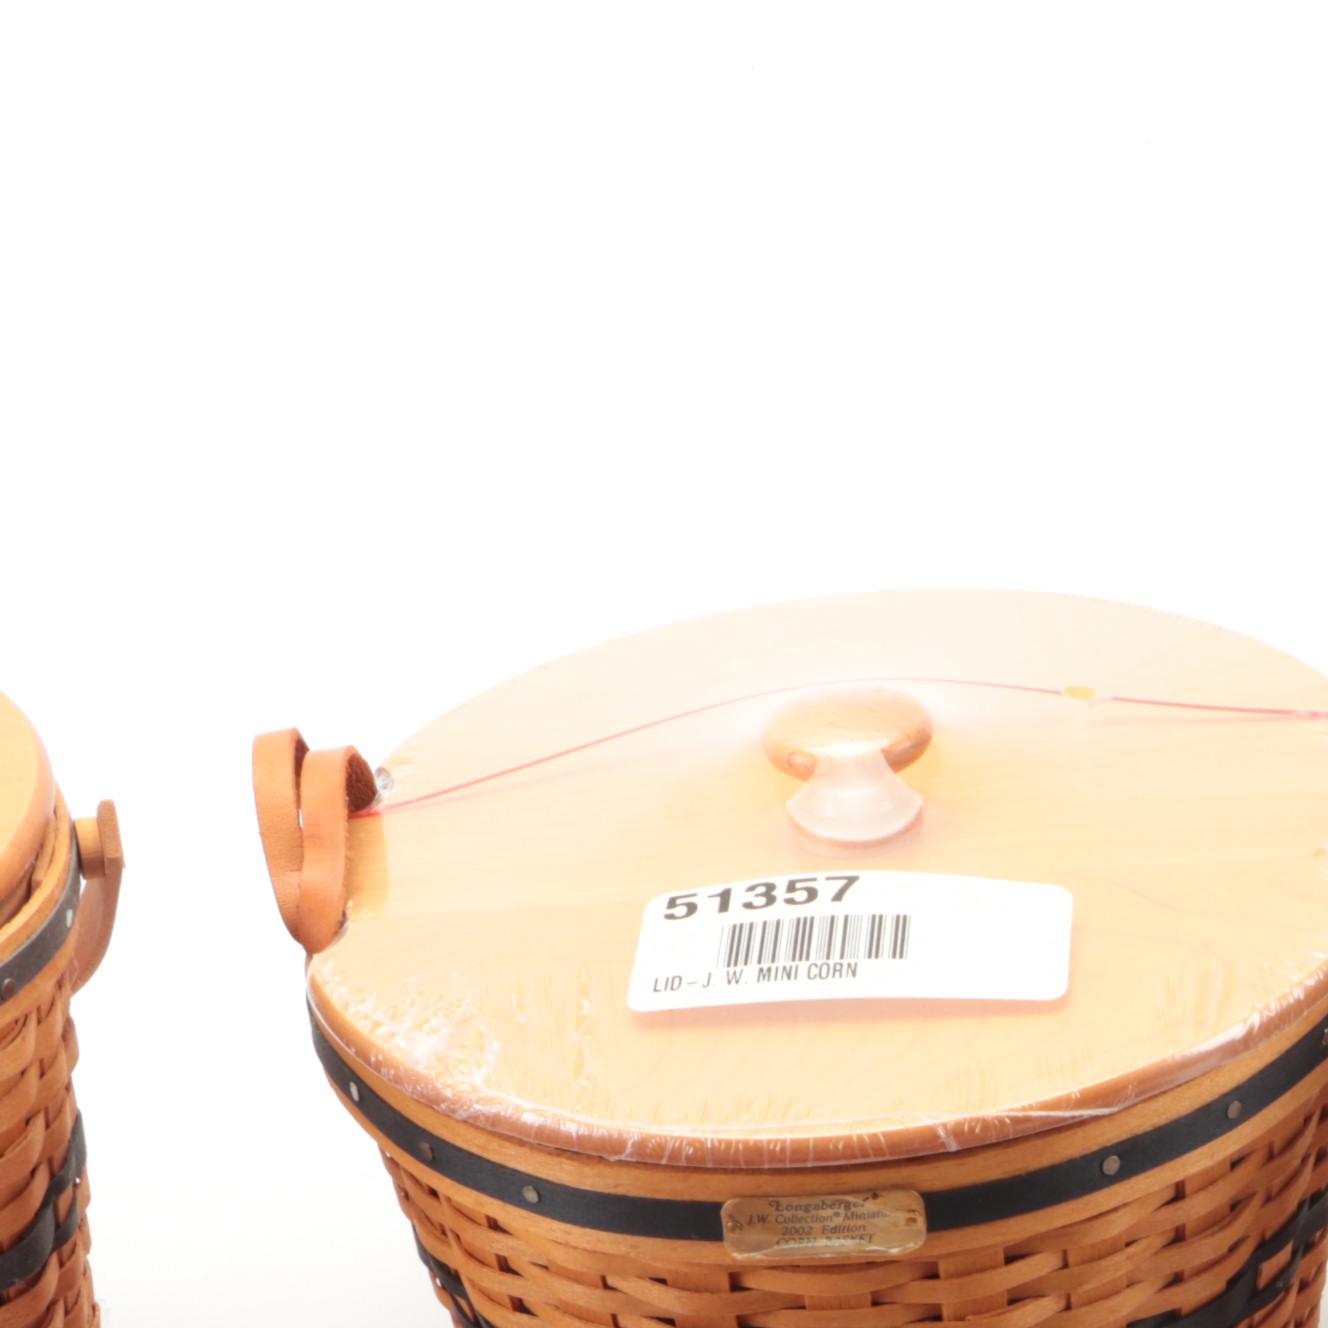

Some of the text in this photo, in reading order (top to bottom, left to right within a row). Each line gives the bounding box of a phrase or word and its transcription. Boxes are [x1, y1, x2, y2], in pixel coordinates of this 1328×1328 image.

[663, 875, 860, 921] 51357
[757, 964, 799, 983] MINI
[807, 962, 858, 980] CORN
[781, 1224, 866, 1236] 2002 Edition
